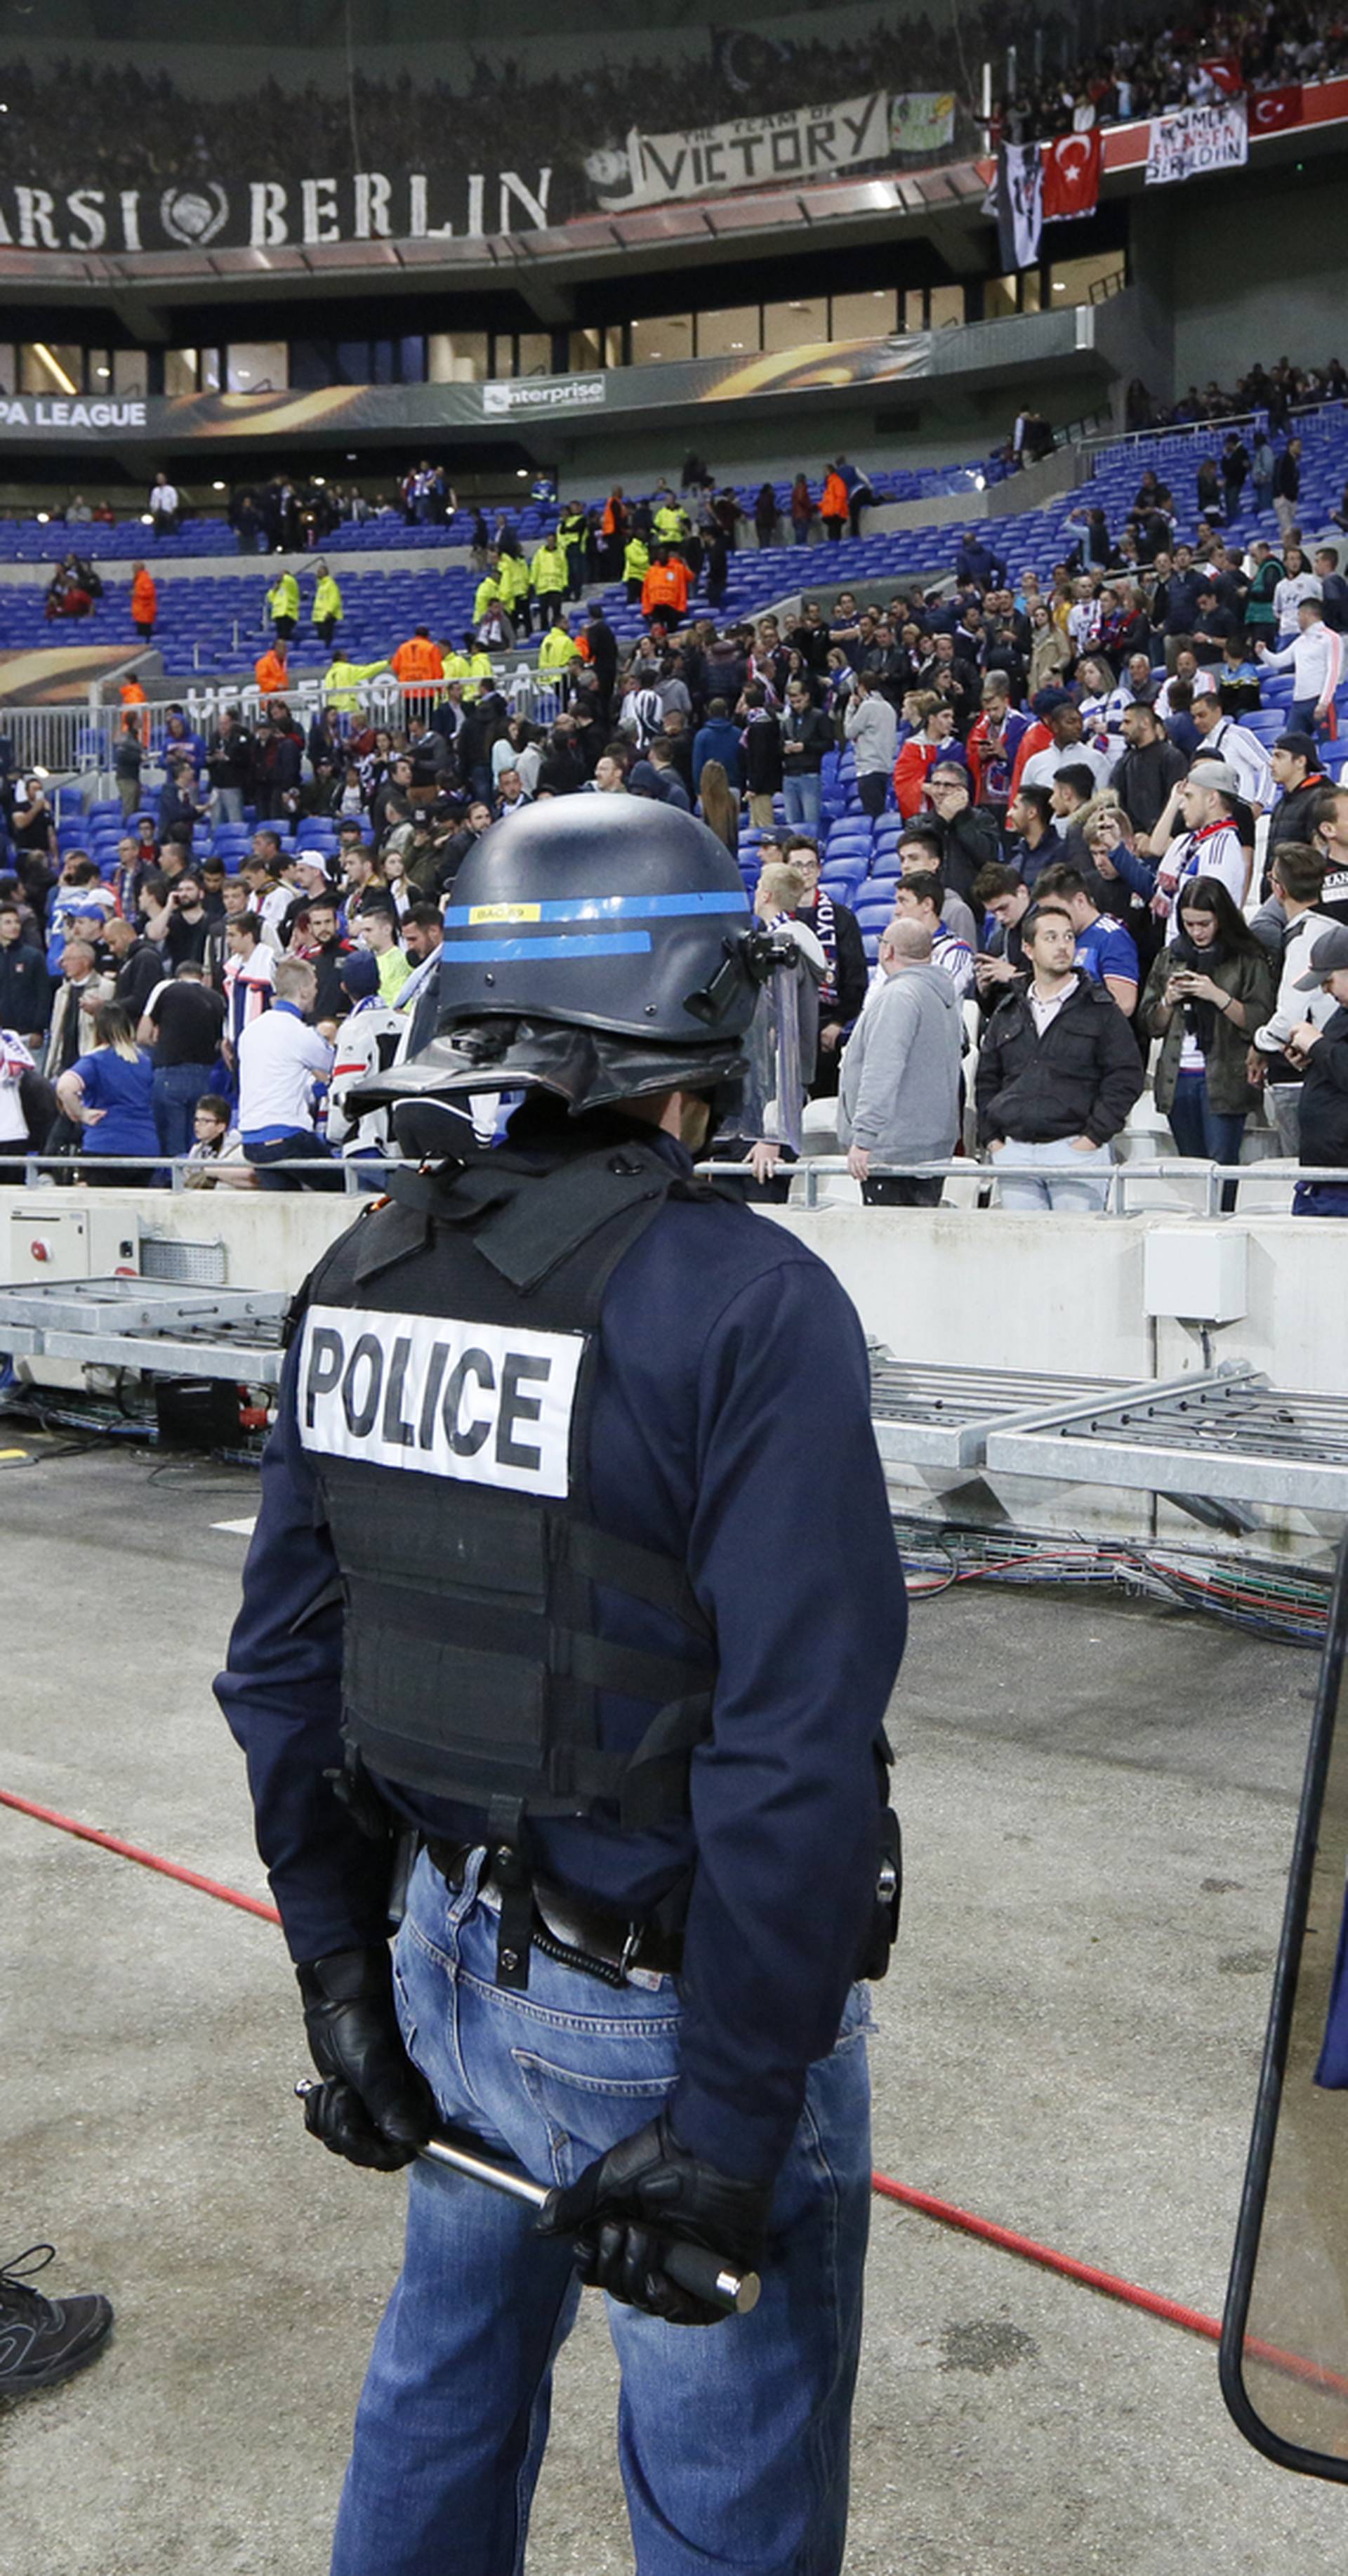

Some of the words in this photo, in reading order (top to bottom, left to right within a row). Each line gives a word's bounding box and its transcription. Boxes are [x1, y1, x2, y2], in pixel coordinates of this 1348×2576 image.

[640, 94, 878, 191] VICTORY
[731, 112, 798, 133] TEAM
[810, 105, 835, 120] OF
[0, 185, 143, 251] RSI
[249, 167, 552, 247] BERLIN
[36, 402, 147, 427] LEAGUE
[817, 893, 836, 946] LYON
[306, 1327, 553, 1471] POLICE
